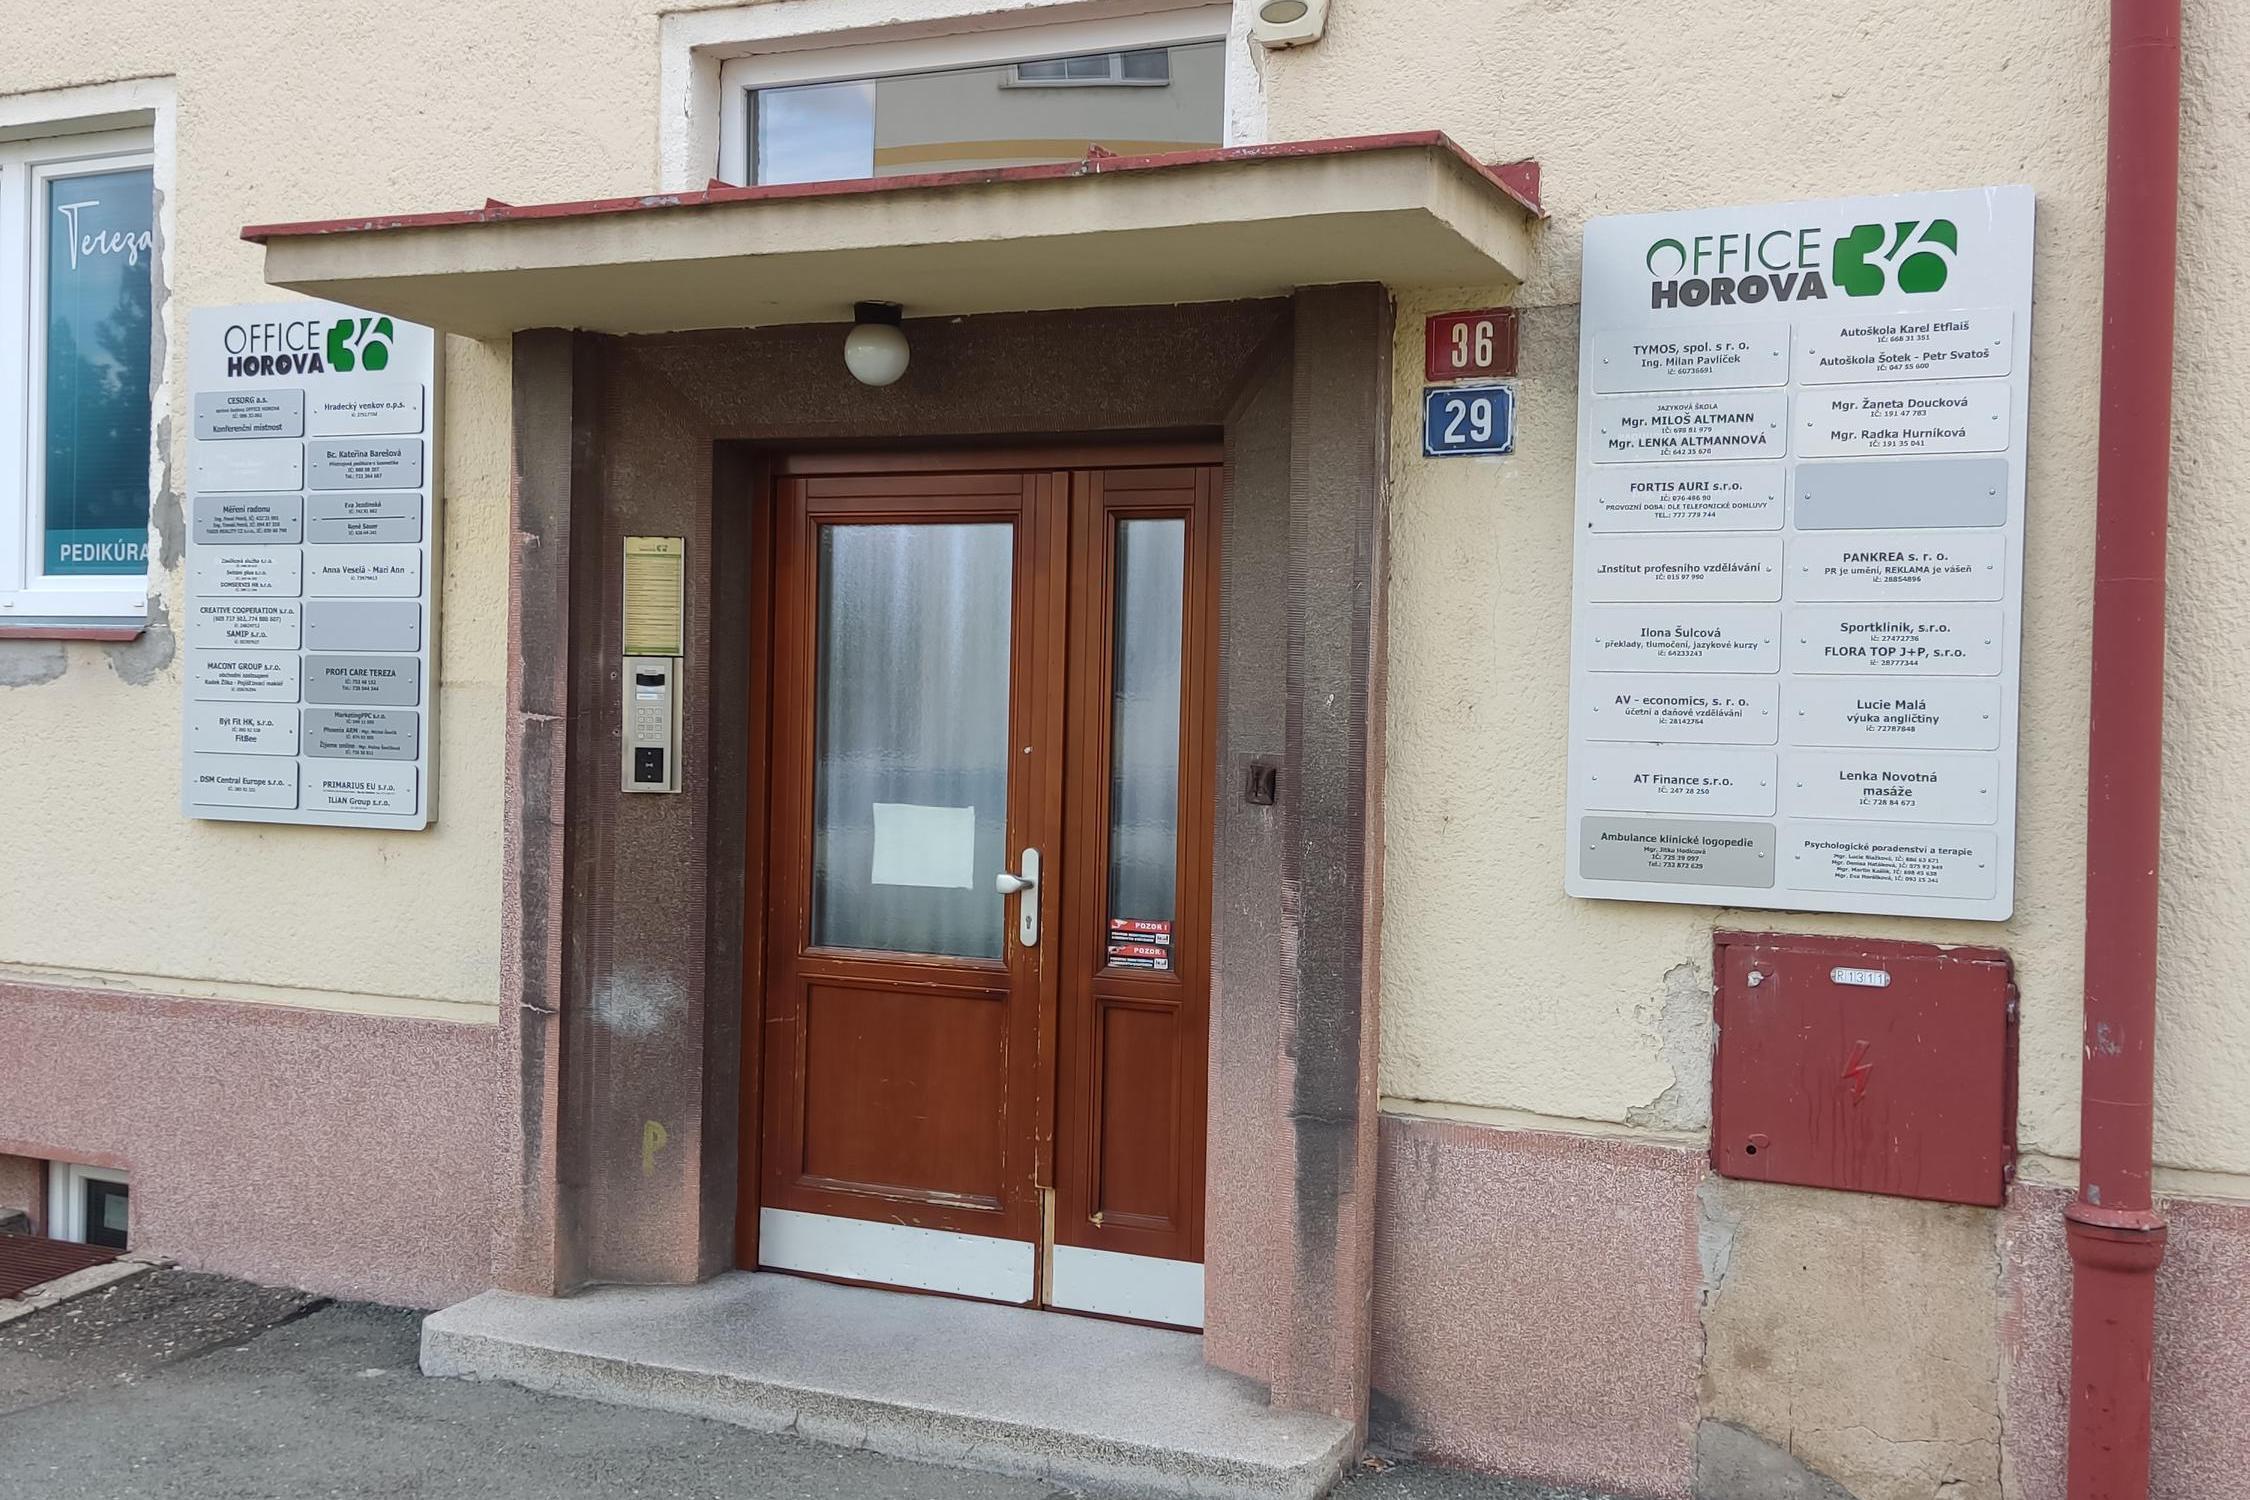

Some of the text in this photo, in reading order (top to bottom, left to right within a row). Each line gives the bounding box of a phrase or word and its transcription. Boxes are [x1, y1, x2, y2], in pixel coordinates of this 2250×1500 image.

[58, 201, 152, 269] Tereza
[1646, 228, 1821, 278] OFFICE
[1833, 219, 1957, 297] 36
[1651, 271, 1828, 309] HOROVA
[1840, 321, 1969, 337] Autoškola Karel Etflaiš
[224, 321, 320, 354] OFFICE
[1452, 321, 1494, 367] 36
[327, 317, 393, 372] 36
[1634, 344, 1679, 355] TYMOS,
[1683, 342, 1711, 353] spol.
[1642, 354, 1740, 368] Ing. Milan Pavlíček
[1820, 355, 1875, 366] Autoškola
[1878, 352, 1911, 363] Šotek
[1923, 352, 1947, 361] Petr
[1950, 349, 1989, 359] Svatoš
[228, 353, 324, 377] HOROVA
[325, 402, 357, 411] Hradecký
[1658, 402, 1718, 411] JAZYKOVÁ ŠKOLA
[1832, 398, 1968, 411] Mgr. Žaneta Doucková
[1445, 398, 1492, 443] 29
[1622, 413, 1754, 428] Mgr. MILOŠ ALTMANN
[1609, 432, 1766, 450] Mgr. LENKA ALTMANNOVÁ
[1831, 428, 1966, 441] Mgr. Radka Hurníková
[1630, 482, 1742, 492] FORTIS AURI s.r.o.
[60, 539, 149, 561] PEDIKÚRA
[1843, 552, 1904, 562] PANKREA
[1937, 553, 1948, 561] o.
[1602, 562, 1761, 574] Institut profesního vzdělávání
[1840, 567, 1848, 576] je
[1851, 567, 1882, 576] umění,
[1932, 566, 1941, 574] je
[1641, 626, 1721, 638] Ilona Šulcová
[1840, 623, 1950, 633] Sportklinik, s.r.o.
[1605, 641, 1758, 650] překlady, tlumočení, jazykové kurzy
[1825, 647, 1866, 656] FLORA
[1870, 647, 1896, 656] TOP
[1900, 648, 1929, 659] J+P,
[1615, 696, 1631, 704] AV
[1643, 697, 1708, 707] economics,
[1712, 698, 1722, 706] s.
[1726, 698, 1734, 706] r.
[1738, 698, 1749, 706] o.
[1858, 699, 1926, 710] Lucie Malá
[1625, 708, 1651, 716] účetní
[1696, 709, 1742, 717] vzdělávání
[1847, 713, 1939, 725] výuka angličtiny
[243, 778, 265, 786] Europe
[1634, 774, 1733, 786] AT Finance s.r.o.
[1840, 771, 1937, 782] Lenka Novotná
[323, 781, 364, 789] PRIMARIUS
[1863, 786, 1912, 796] masáže
[349, 798, 371, 806] Group
[1601, 833, 1753, 848] Ambulance klinické logopedie
[1804, 841, 1869, 851] Psychologické
[1872, 845, 1927, 853] poradenství
[1939, 848, 1973, 856] terapie
[1836, 971, 1884, 984] R1311
